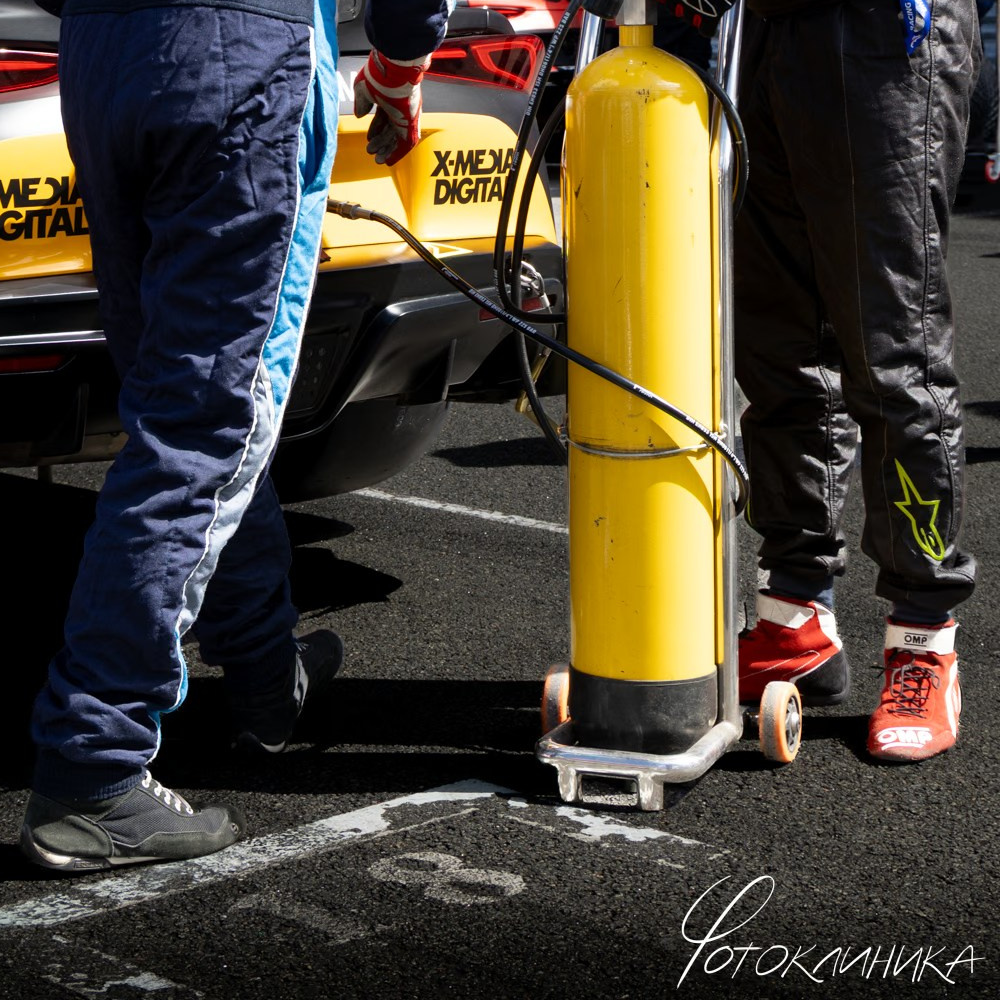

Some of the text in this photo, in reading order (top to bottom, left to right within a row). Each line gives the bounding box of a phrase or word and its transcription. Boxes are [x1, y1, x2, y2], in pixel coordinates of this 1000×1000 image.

[433, 175, 508, 205] DIGITA
[904, 634, 928, 645] OMP
[876, 728, 933, 746] OMP
